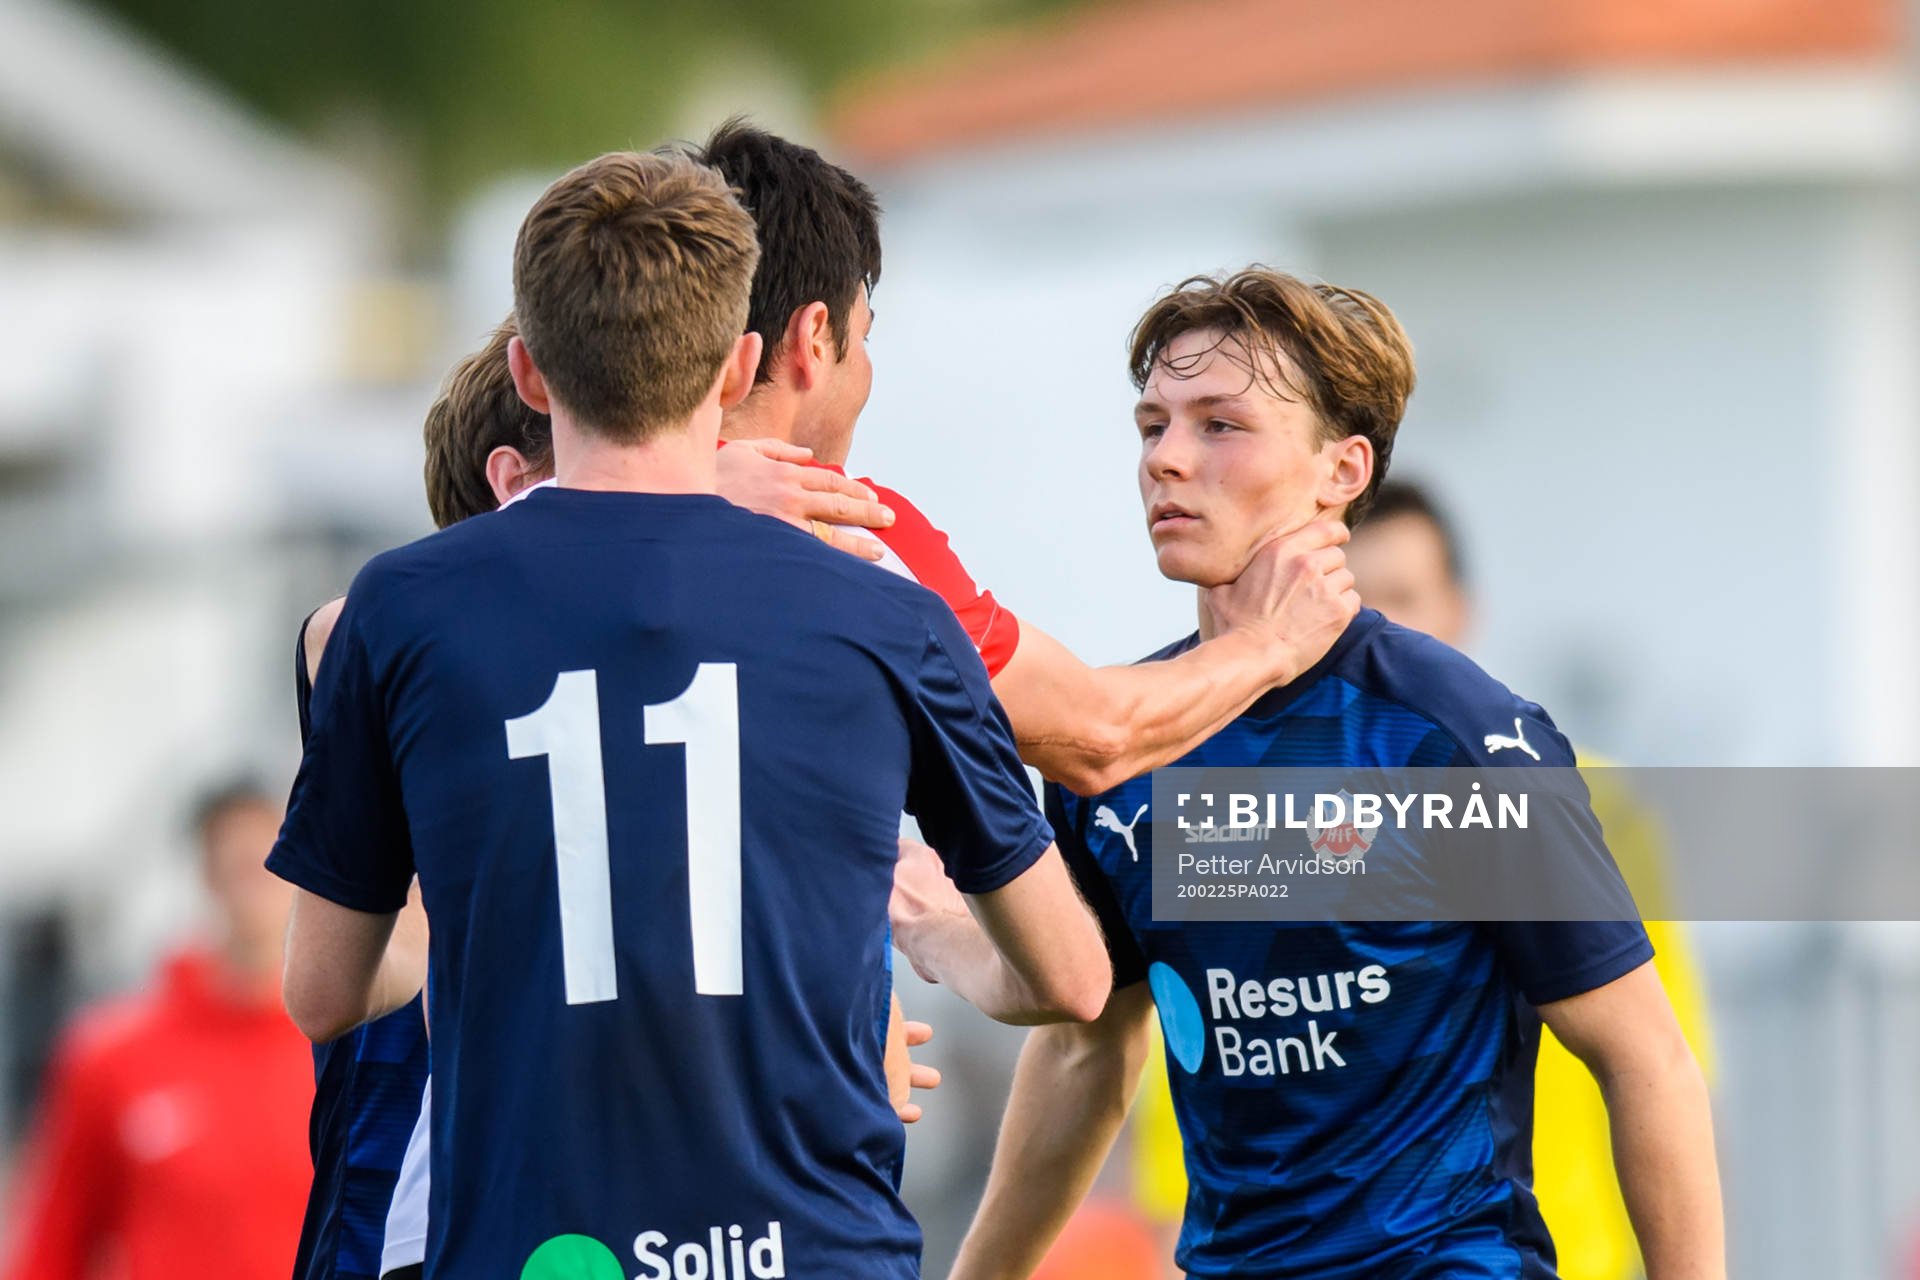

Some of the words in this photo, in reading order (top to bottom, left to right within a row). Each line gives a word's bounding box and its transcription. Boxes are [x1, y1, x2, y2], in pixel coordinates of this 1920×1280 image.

[505, 662, 744, 1005] 11
[1206, 964, 1391, 1020] Resurs
[1214, 1020, 1347, 1077] Bank
[633, 1221, 786, 1280] Solid
